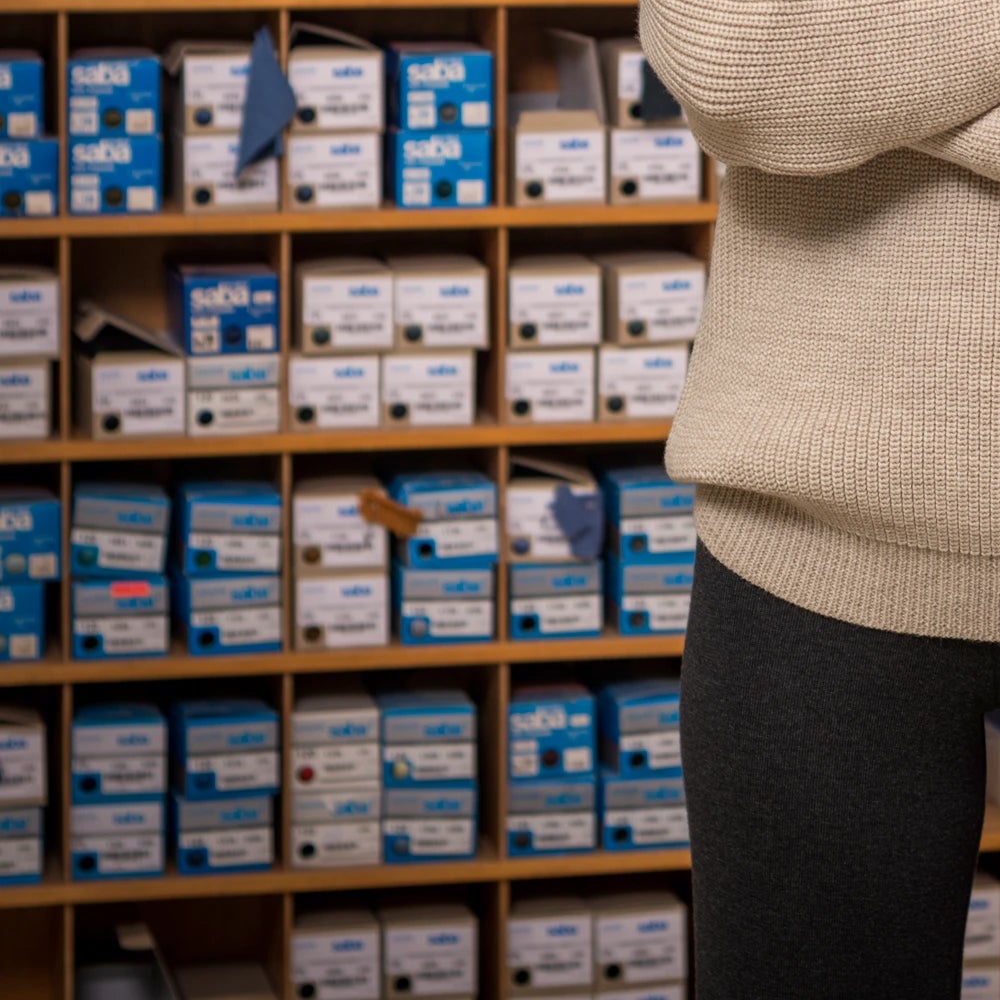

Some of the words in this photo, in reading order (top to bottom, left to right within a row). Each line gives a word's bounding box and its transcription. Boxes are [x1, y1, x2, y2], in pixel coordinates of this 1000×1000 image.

[72, 63, 130, 85] saba
[408, 60, 465, 85] saba
[0, 145, 30, 167] ba
[73, 141, 131, 163] saba
[404, 137, 462, 162] saba
[191, 285, 250, 310] saba
[0, 510, 33, 531] ba
[511, 709, 567, 732] saba
